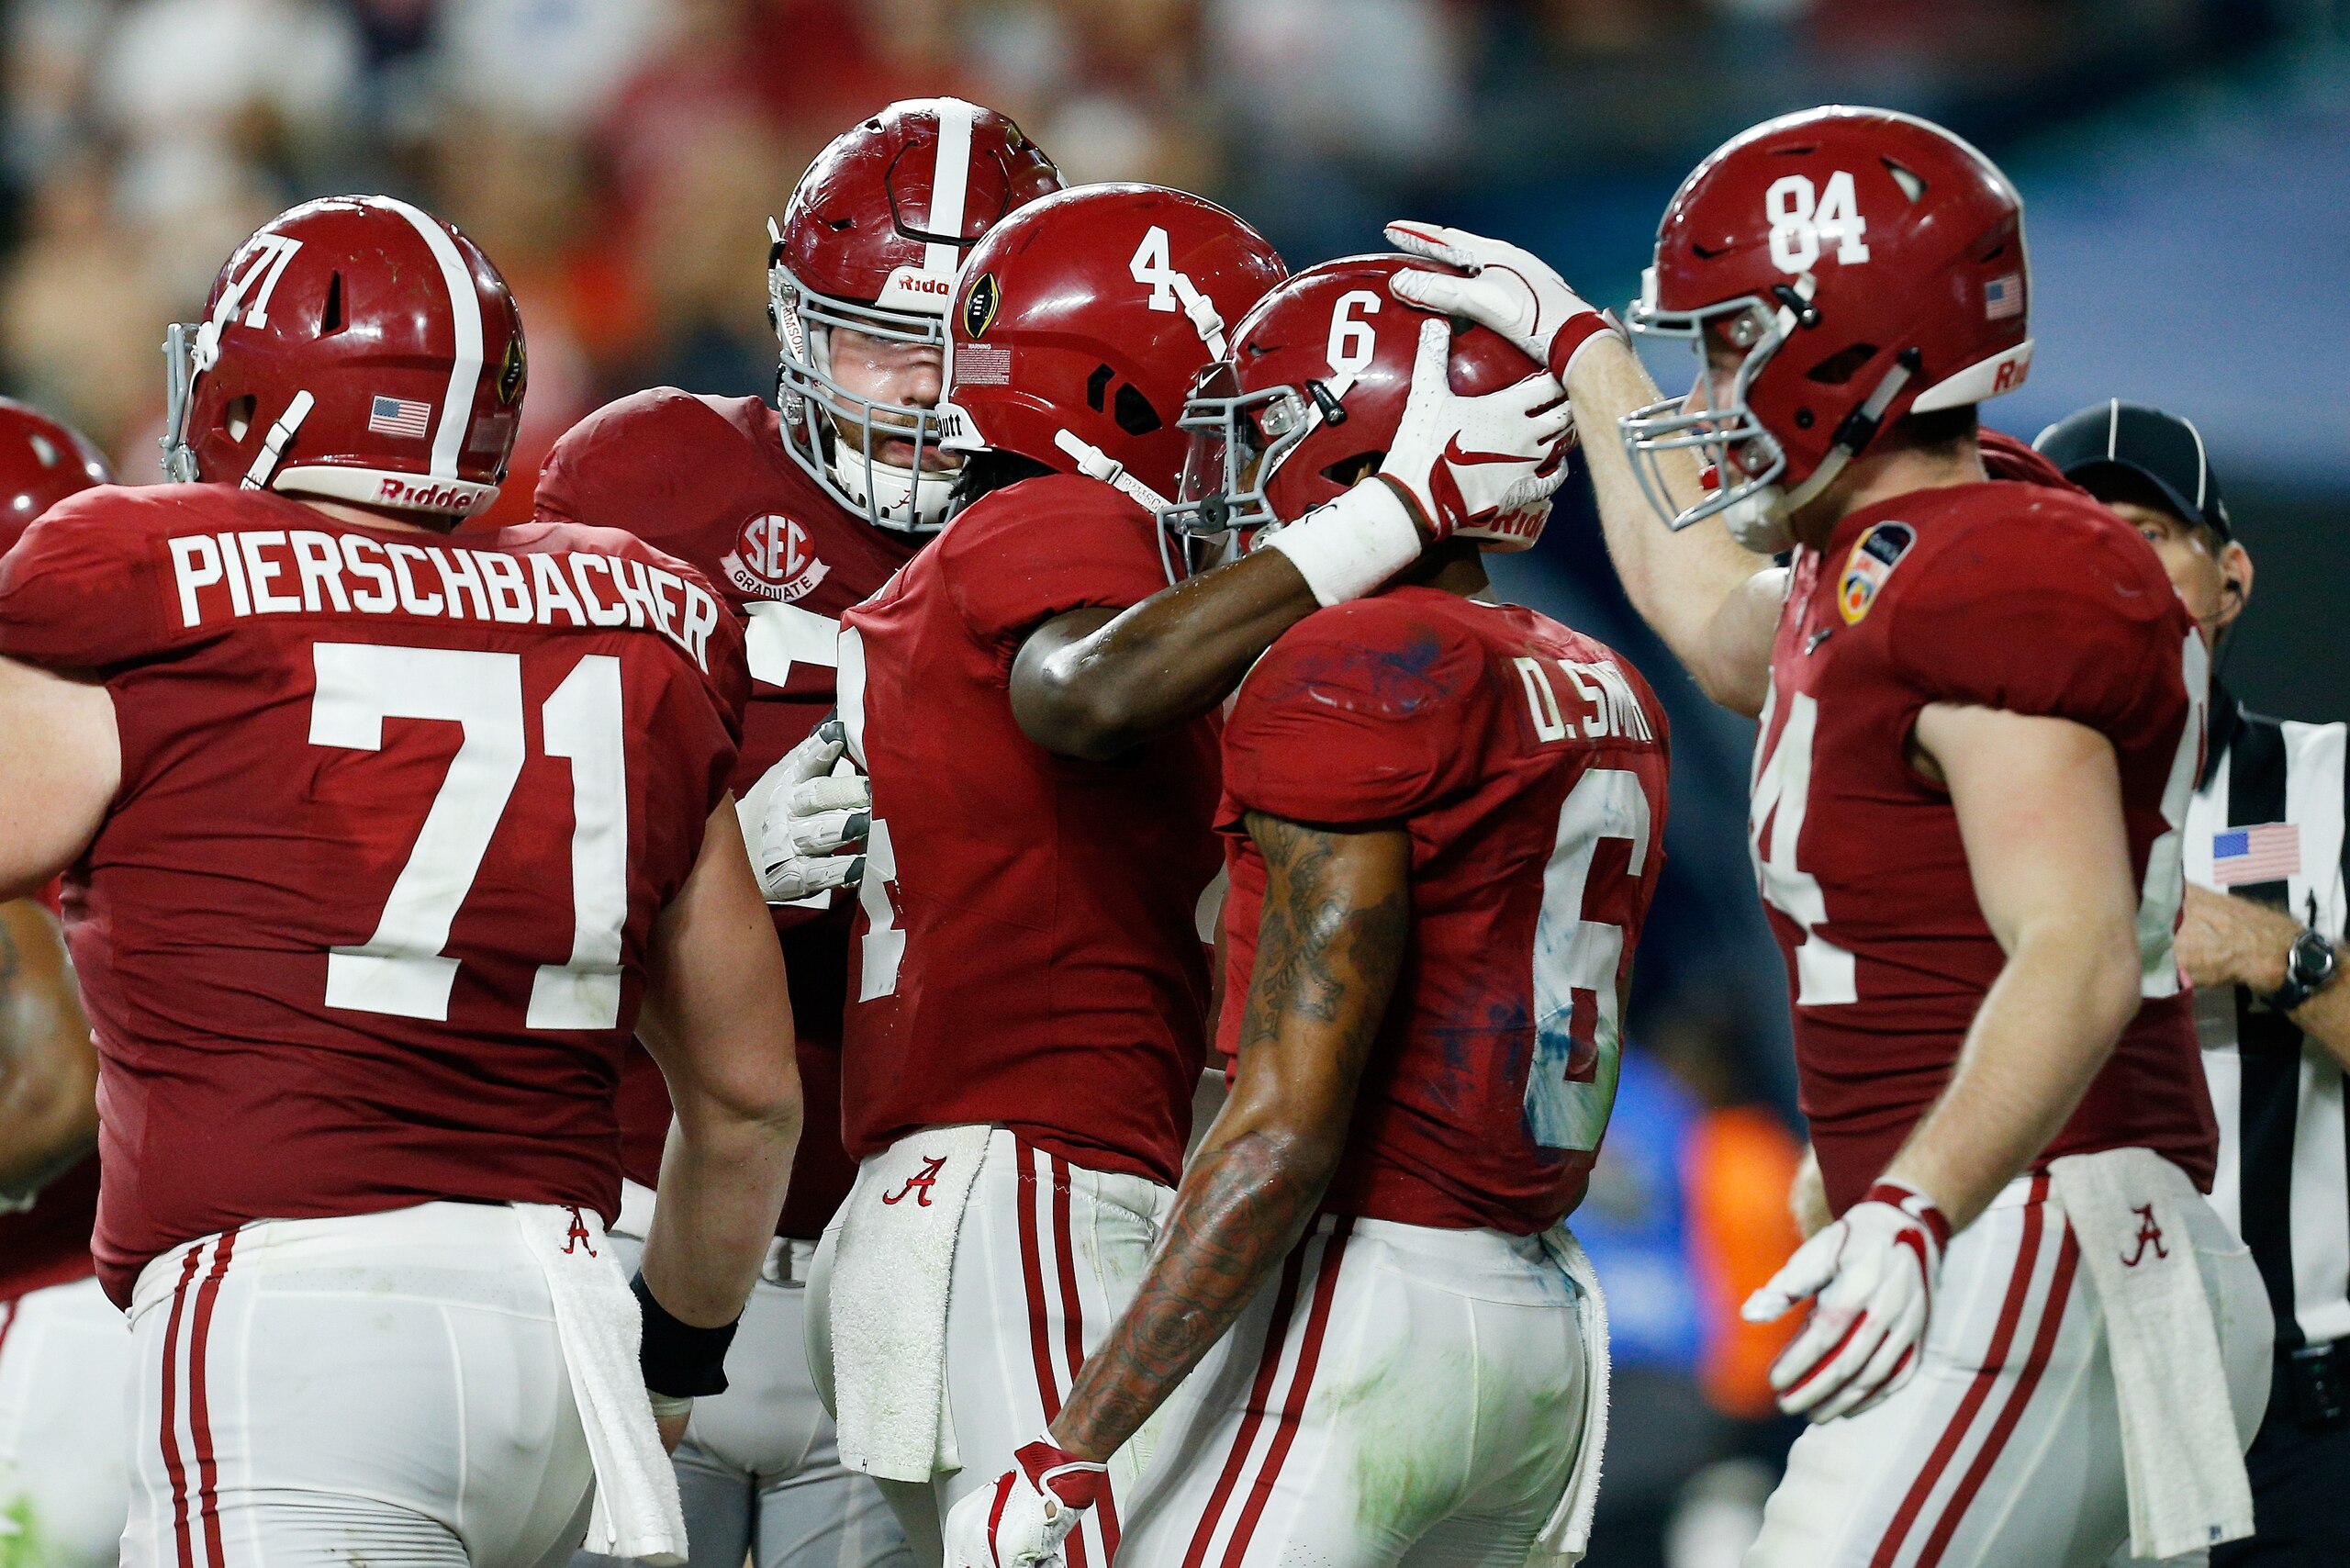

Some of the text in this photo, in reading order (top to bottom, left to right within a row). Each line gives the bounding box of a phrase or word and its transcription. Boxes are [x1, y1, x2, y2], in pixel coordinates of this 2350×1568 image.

[1129, 225, 1177, 312] 4
[1765, 170, 1870, 274] 84
[235, 232, 304, 330] 71
[1326, 289, 1382, 375] 6
[733, 570, 813, 600] GRADUATE
[744, 514, 807, 579] SEC
[168, 530, 719, 676] PIERSCHBACHER
[308, 642, 628, 1029] 71
[1523, 767, 1651, 1151] 6
